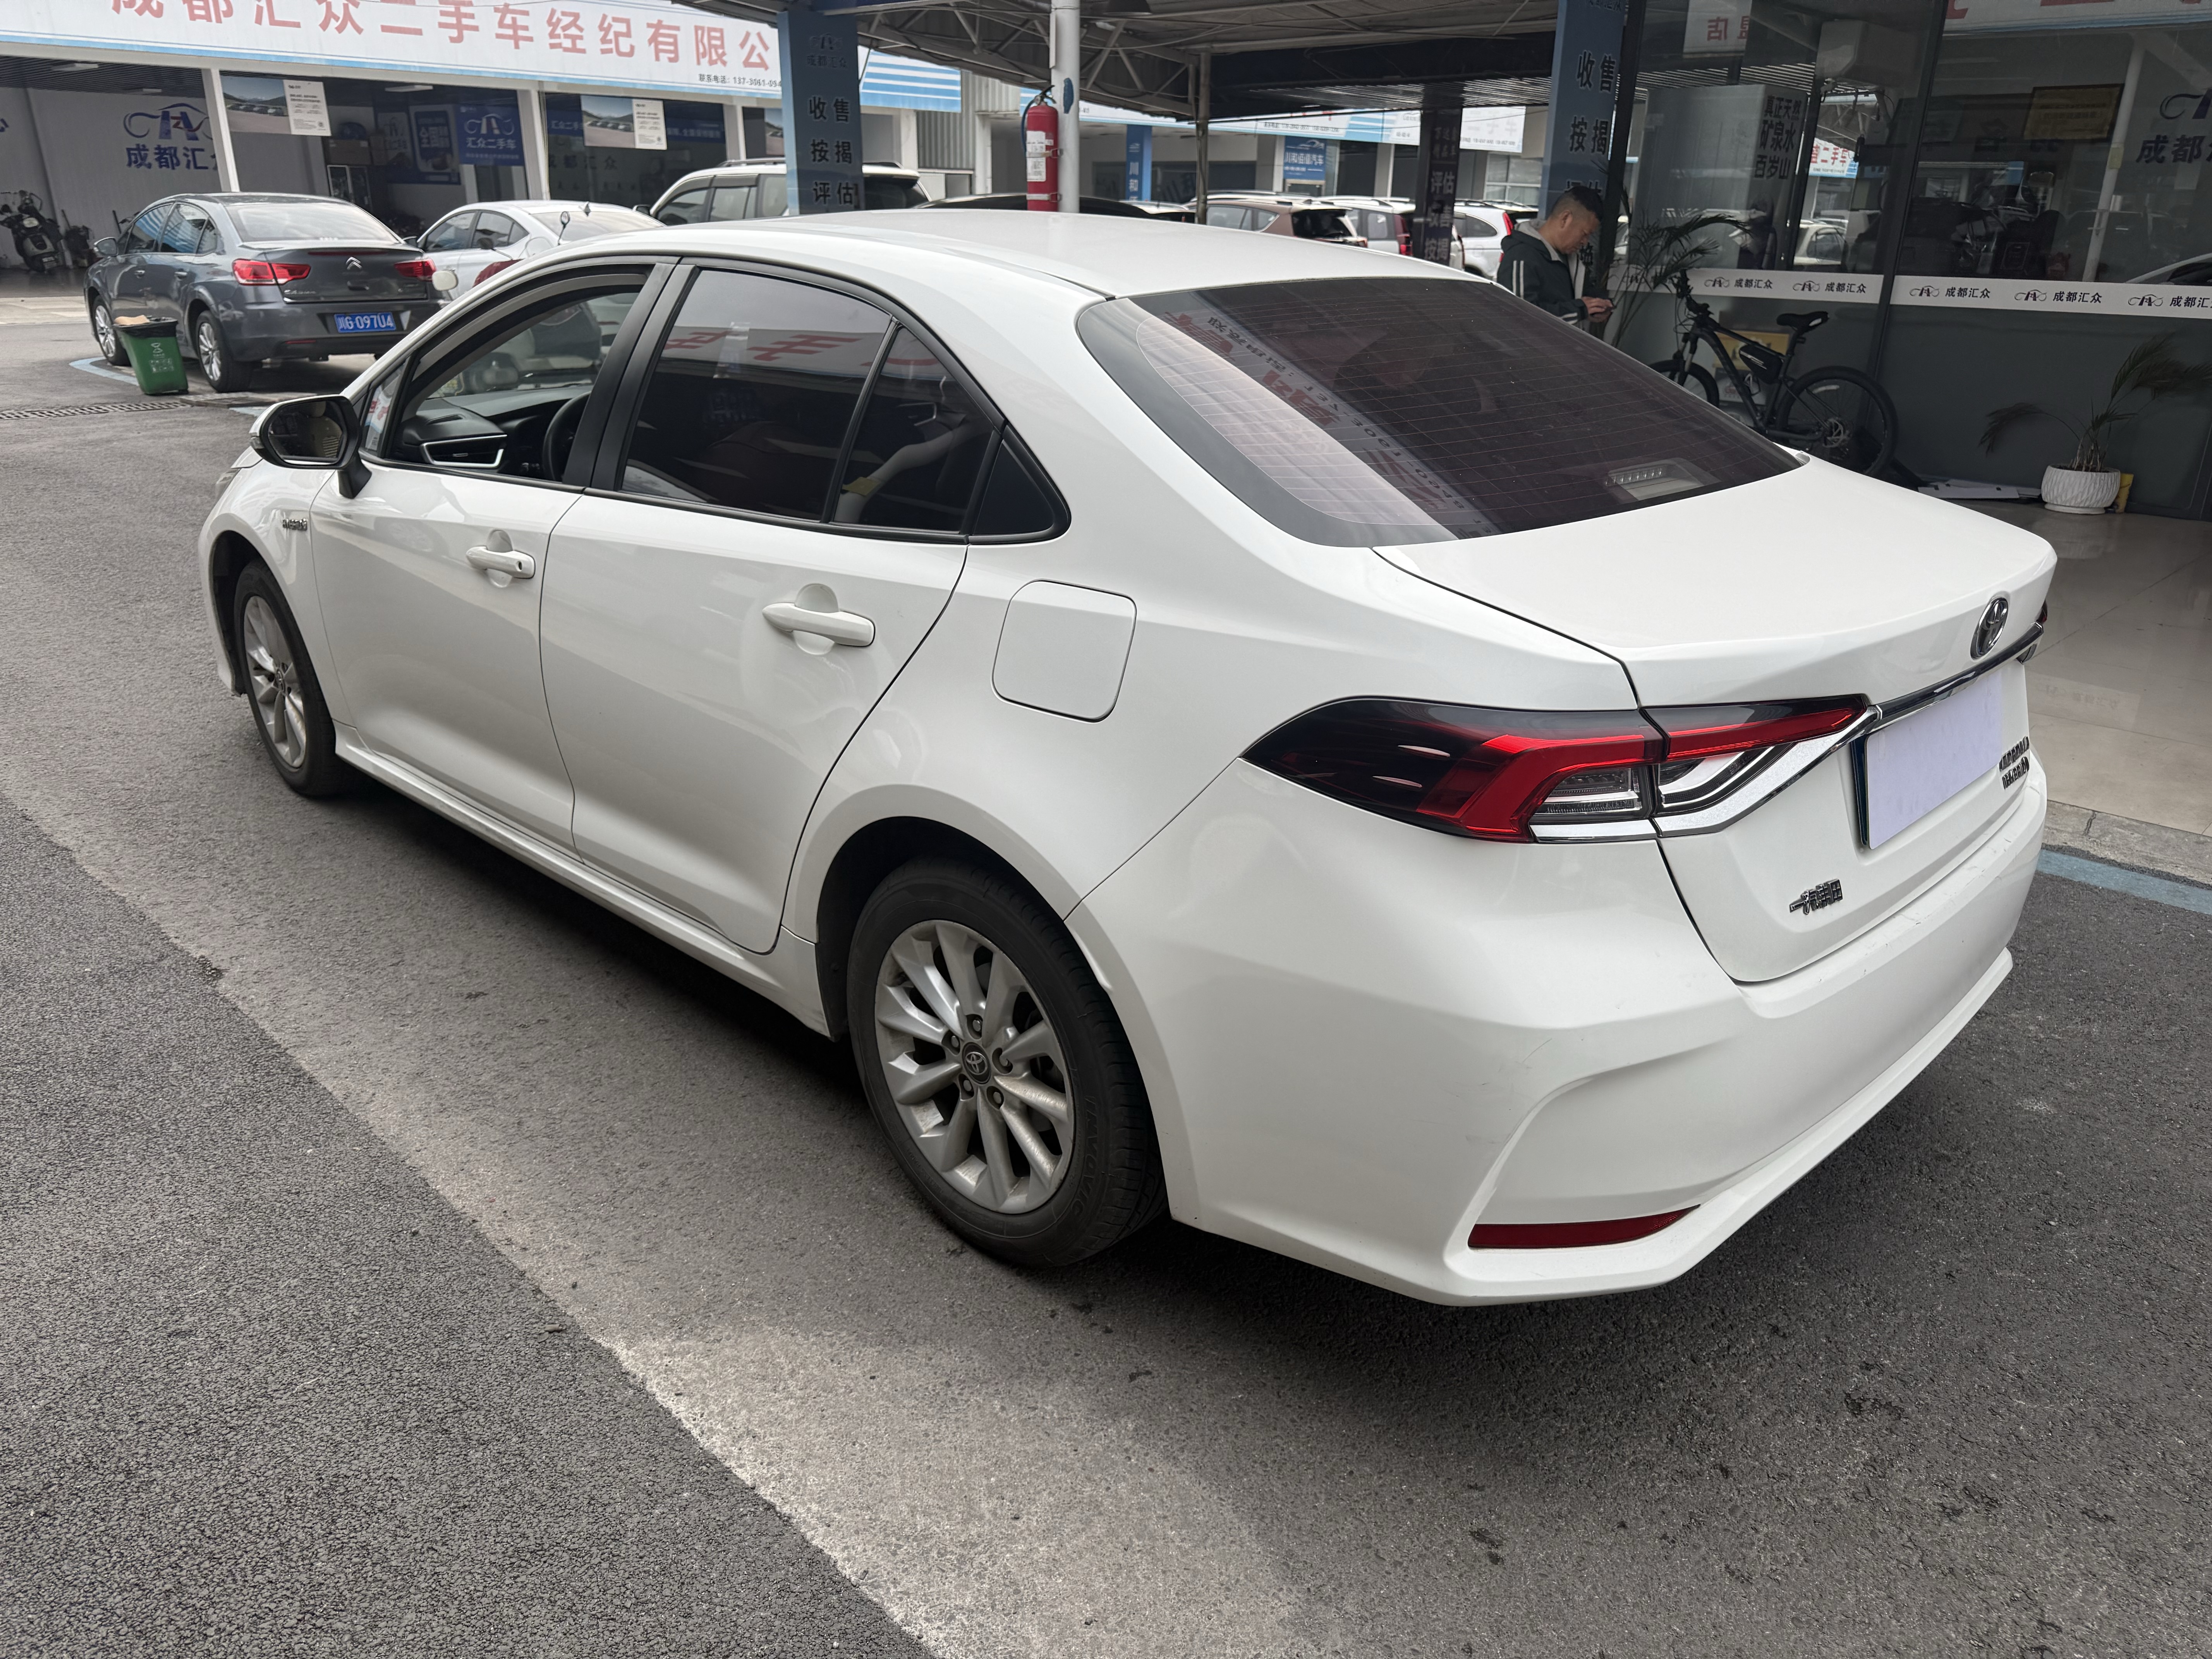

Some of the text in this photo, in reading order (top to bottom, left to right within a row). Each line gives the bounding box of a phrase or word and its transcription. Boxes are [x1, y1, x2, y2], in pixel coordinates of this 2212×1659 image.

[1577, 51, 1615, 92] 收售
[809, 96, 849, 122] 收售
[466, 137, 517, 150] 汇众二手车
[1570, 116, 1608, 155] 按揭
[1759, 120, 1796, 152] 矿泉水
[126, 143, 217, 170] 成都汇
[811, 139, 852, 164] 按揭
[2135, 134, 2212, 163] 成都
[1754, 154, 1791, 179] 百岁山
[813, 181, 853, 205] 评估
[1734, 278, 1773, 289] 成都汇众
[1825, 282, 1867, 294] 成都汇众
[1945, 287, 1990, 299] 成都汇众
[2052, 291, 2102, 304] 成都汇众
[2169, 295, 2212, 308] 成都汇
